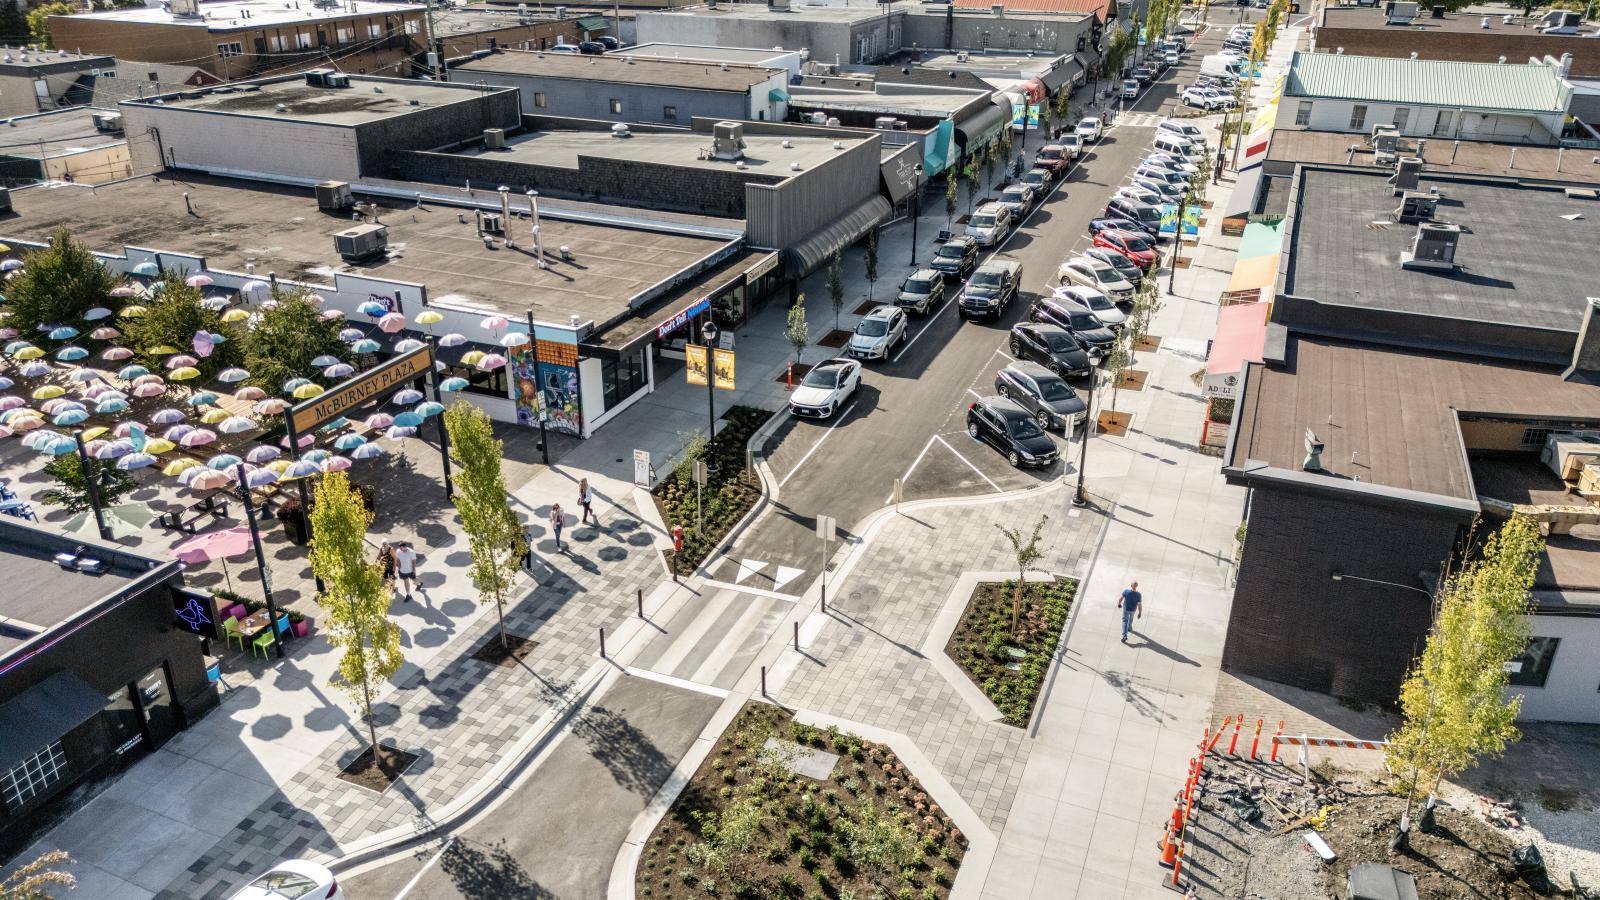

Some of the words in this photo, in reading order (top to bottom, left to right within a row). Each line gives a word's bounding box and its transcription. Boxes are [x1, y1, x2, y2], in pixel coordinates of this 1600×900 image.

[659, 320, 676, 337] Don't
[676, 312, 687, 326] Tell
[315, 377, 379, 421] McBURNEY
[381, 361, 416, 386] PLAZA
